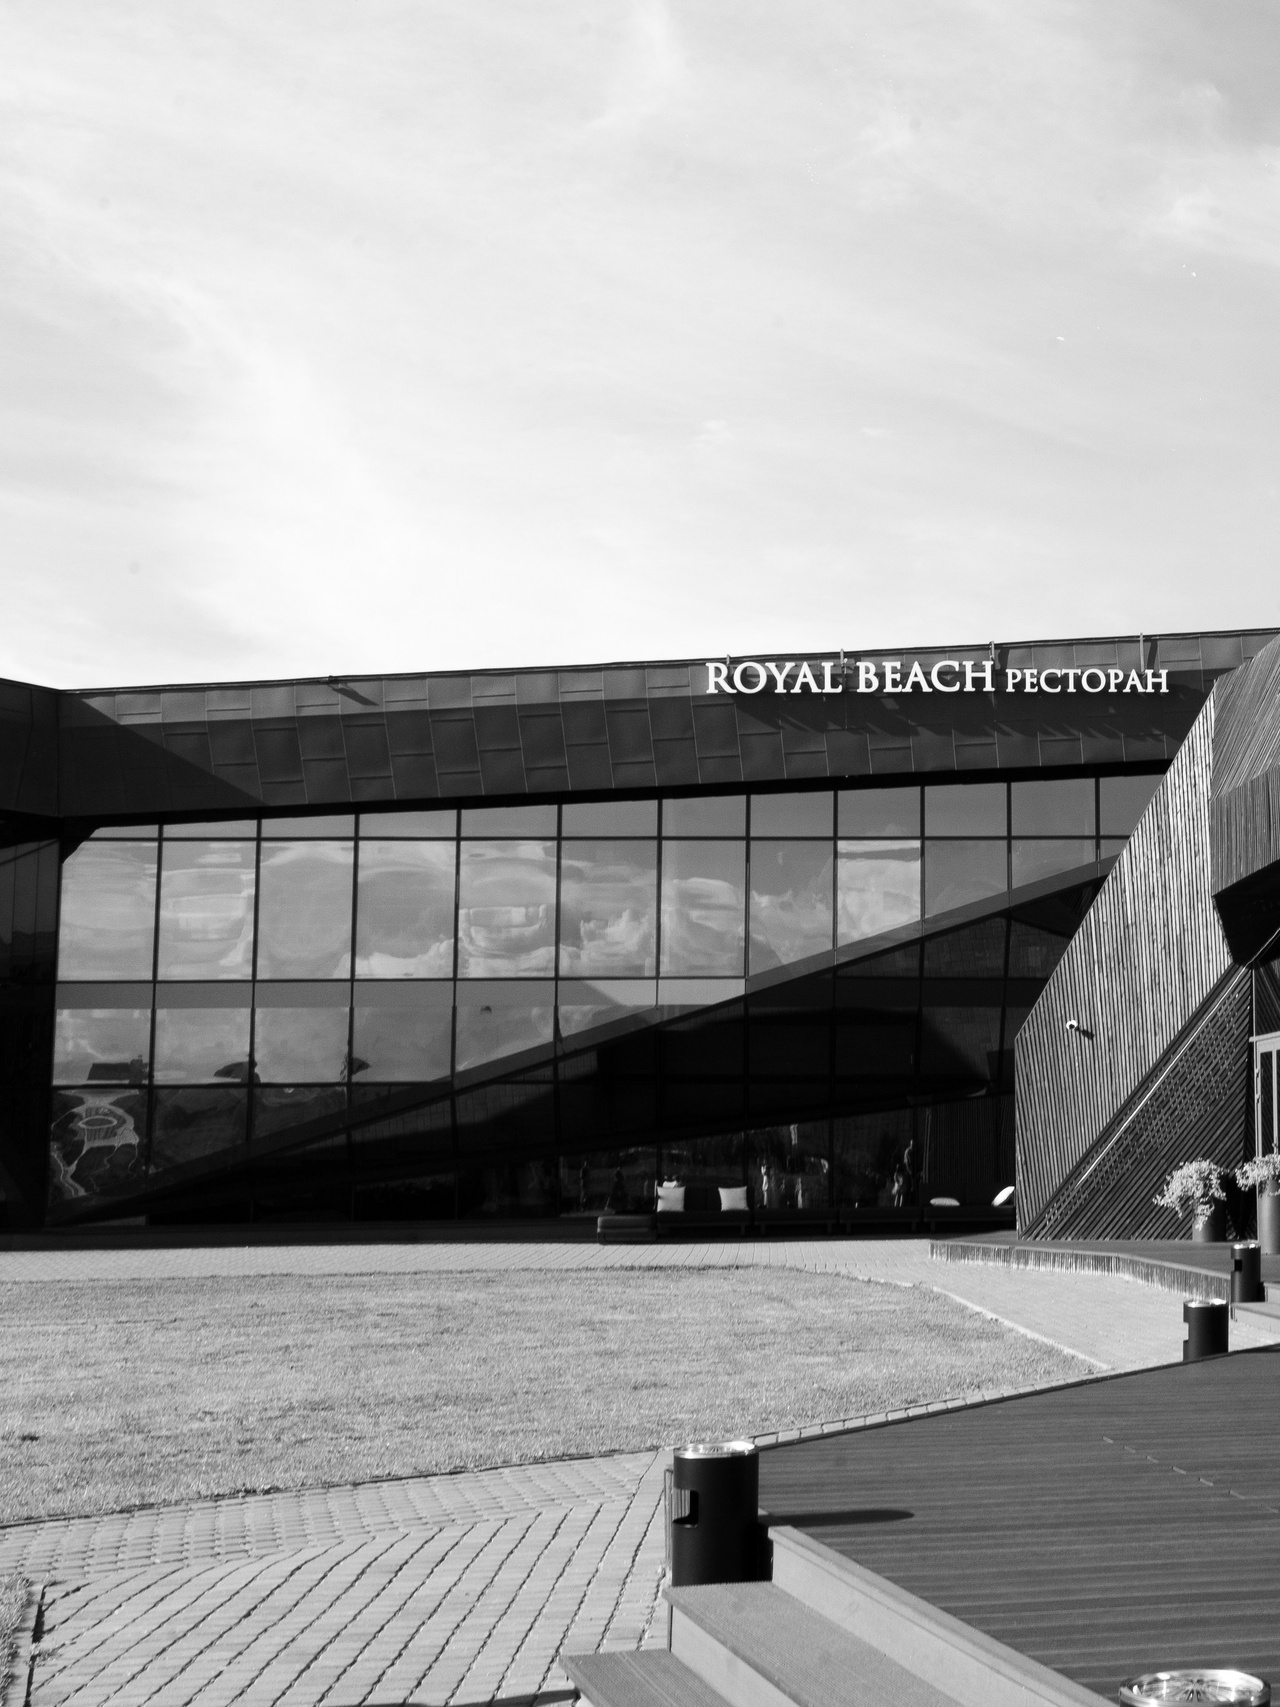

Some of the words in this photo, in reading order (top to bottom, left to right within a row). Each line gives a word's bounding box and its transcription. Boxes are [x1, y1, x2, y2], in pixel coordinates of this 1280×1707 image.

[705, 661, 843, 694] ROYAL
[855, 659, 996, 693] BEACH
[1005, 667, 1170, 694] РЕСТОРАН
